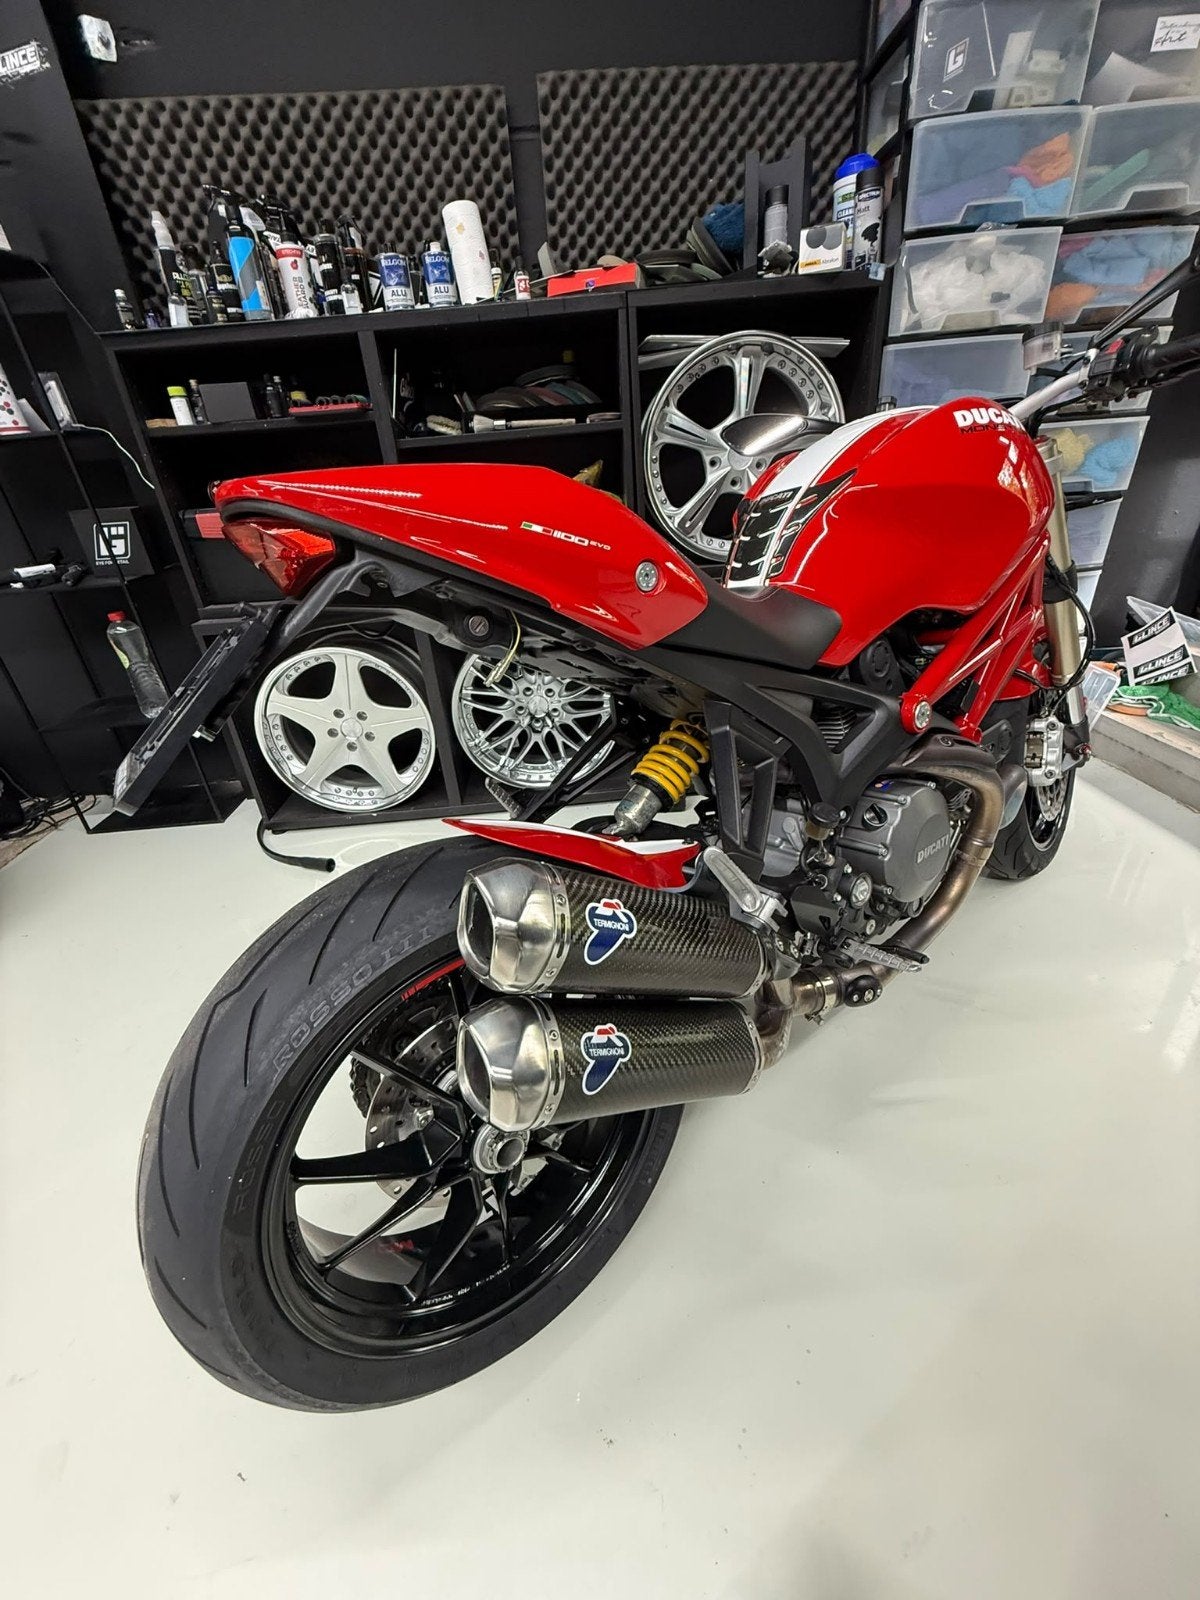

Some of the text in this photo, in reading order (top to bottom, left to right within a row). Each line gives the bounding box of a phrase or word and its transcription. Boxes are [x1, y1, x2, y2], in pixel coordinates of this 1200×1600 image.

[380, 259, 407, 267] BELGOM
[424, 255, 450, 263] BELGOM
[391, 289, 407, 298] ALU
[434, 286, 449, 294] ALU
[553, 529, 611, 551] 1100 EVO
[1138, 648, 1183, 674] GLINCE
[916, 834, 949, 863] DUCATI
[594, 918, 630, 931] TERMIGNONI
[272, 963, 374, 1074] ROSSO
[589, 1047, 625, 1057] TERMIGNONI
